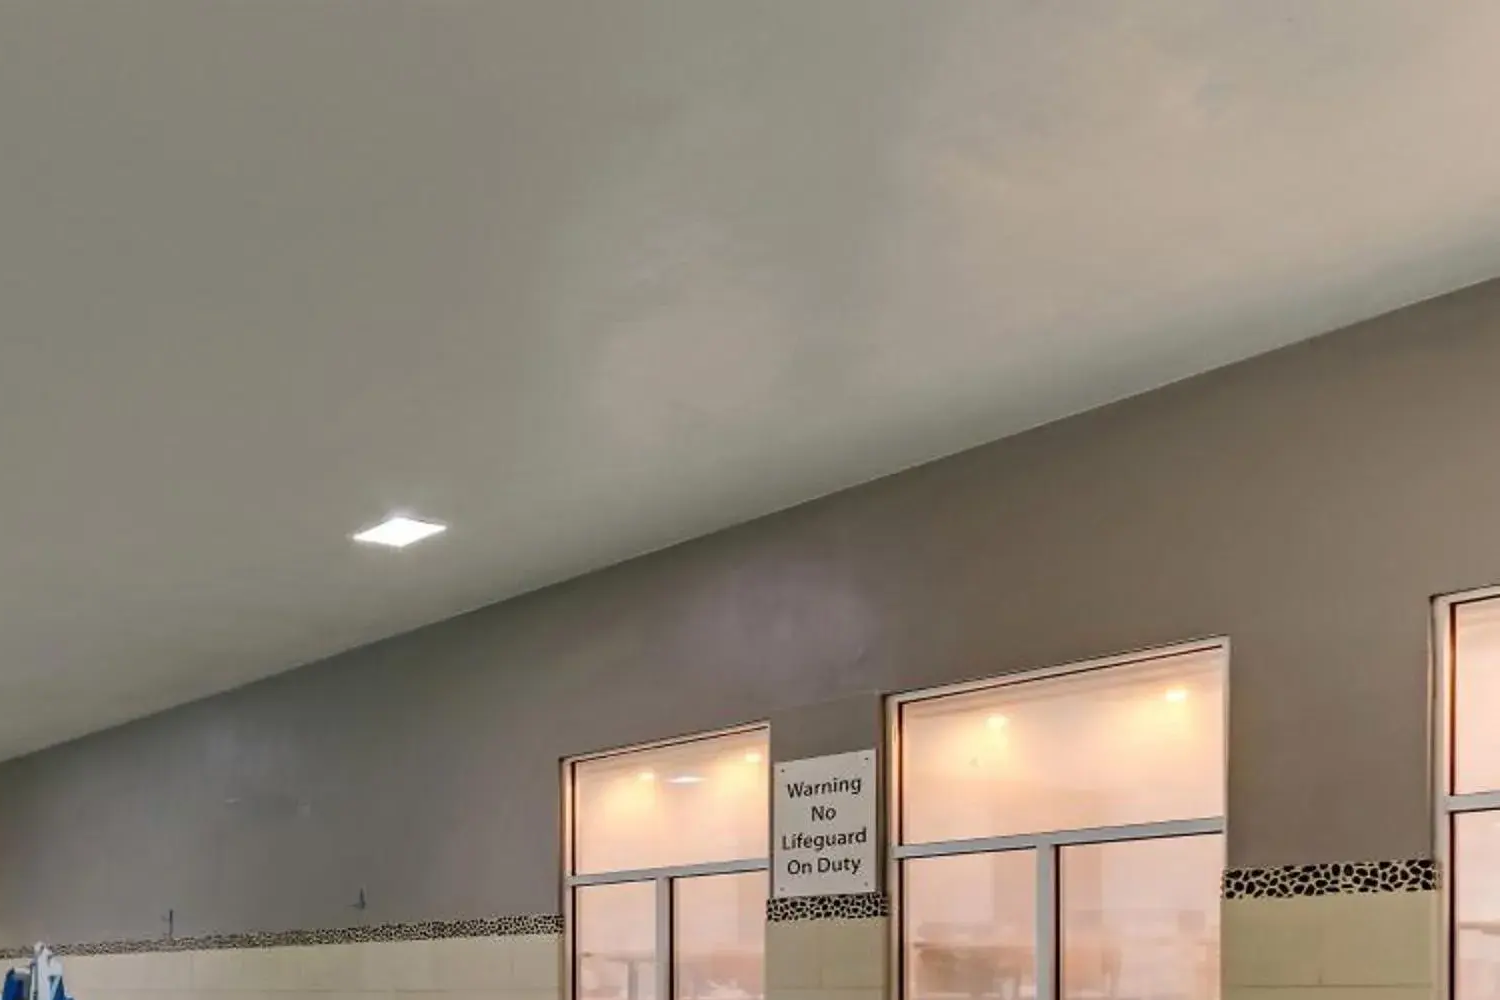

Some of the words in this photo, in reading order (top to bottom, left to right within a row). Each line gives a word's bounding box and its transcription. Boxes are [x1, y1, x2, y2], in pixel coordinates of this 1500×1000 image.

[787, 777, 862, 799] Warning
[811, 806, 837, 822] No
[782, 826, 867, 851] Lifeguard
[787, 859, 813, 875] On
[817, 857, 861, 875] Duty
